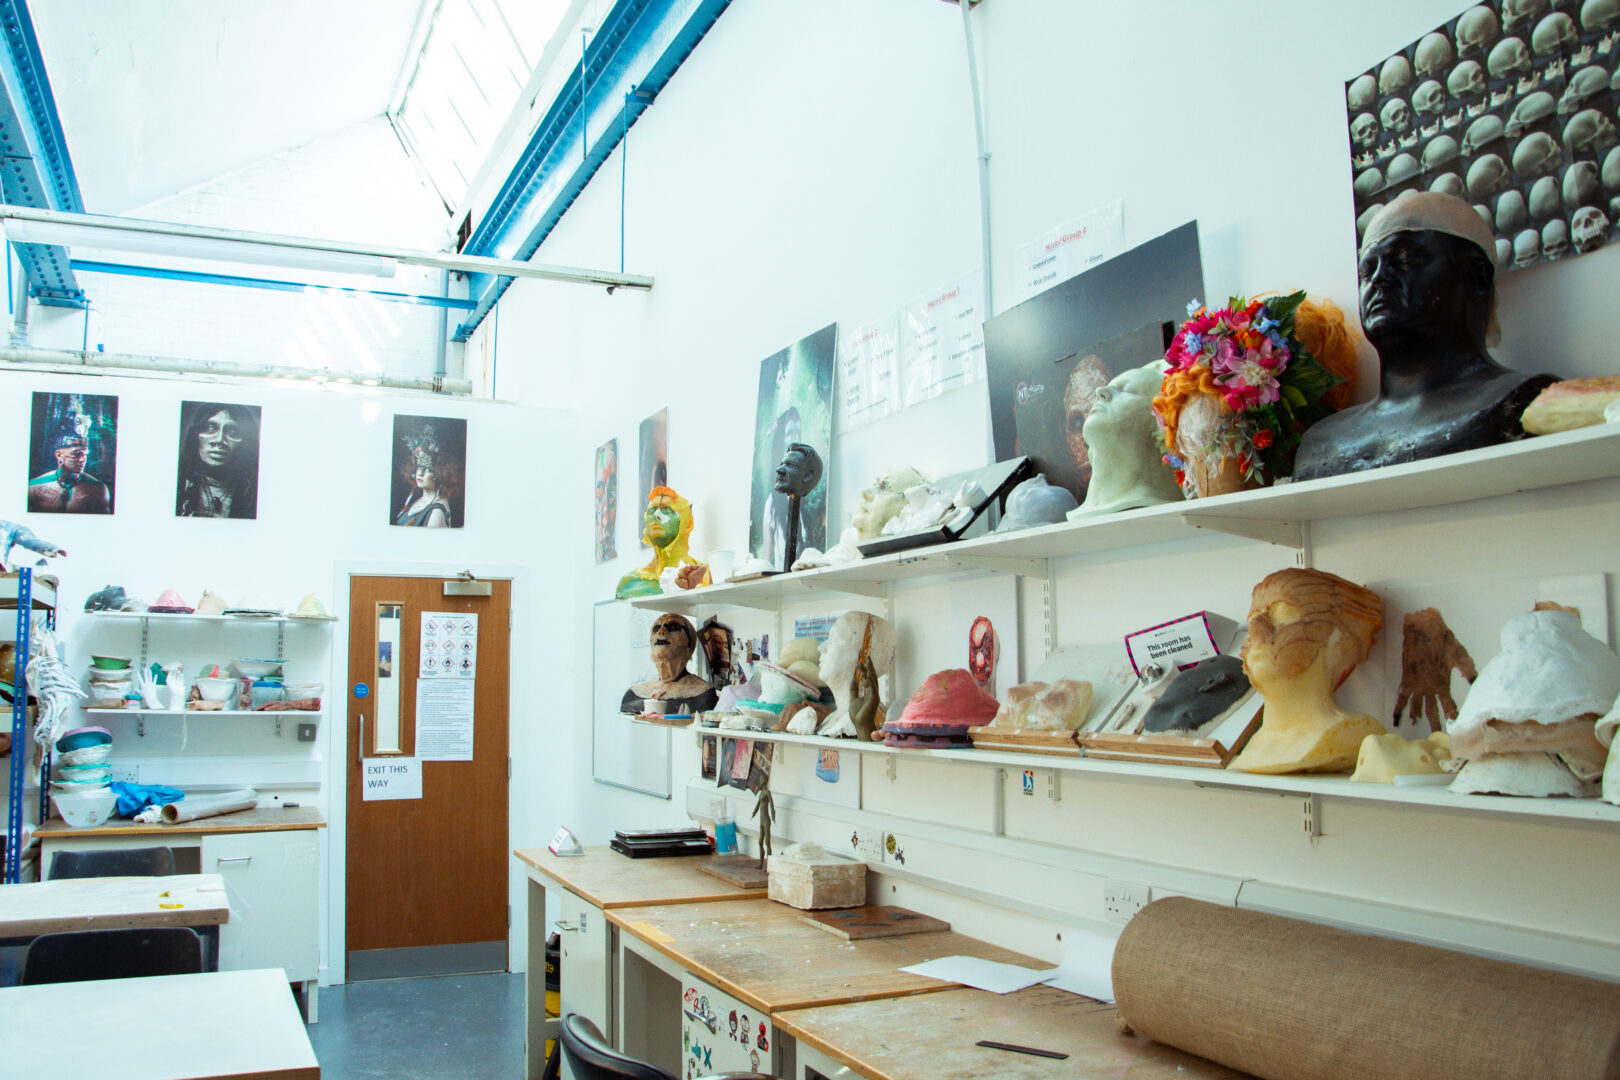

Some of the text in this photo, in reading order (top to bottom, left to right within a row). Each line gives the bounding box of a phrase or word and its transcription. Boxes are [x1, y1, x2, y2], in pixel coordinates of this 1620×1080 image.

[1062, 229, 1081, 242] Group
[1147, 634, 1191, 653] This room has
[1150, 642, 1192, 659] been cleaned
[367, 765, 408, 775] EXIT THIS
[367, 779, 389, 788] WAY
